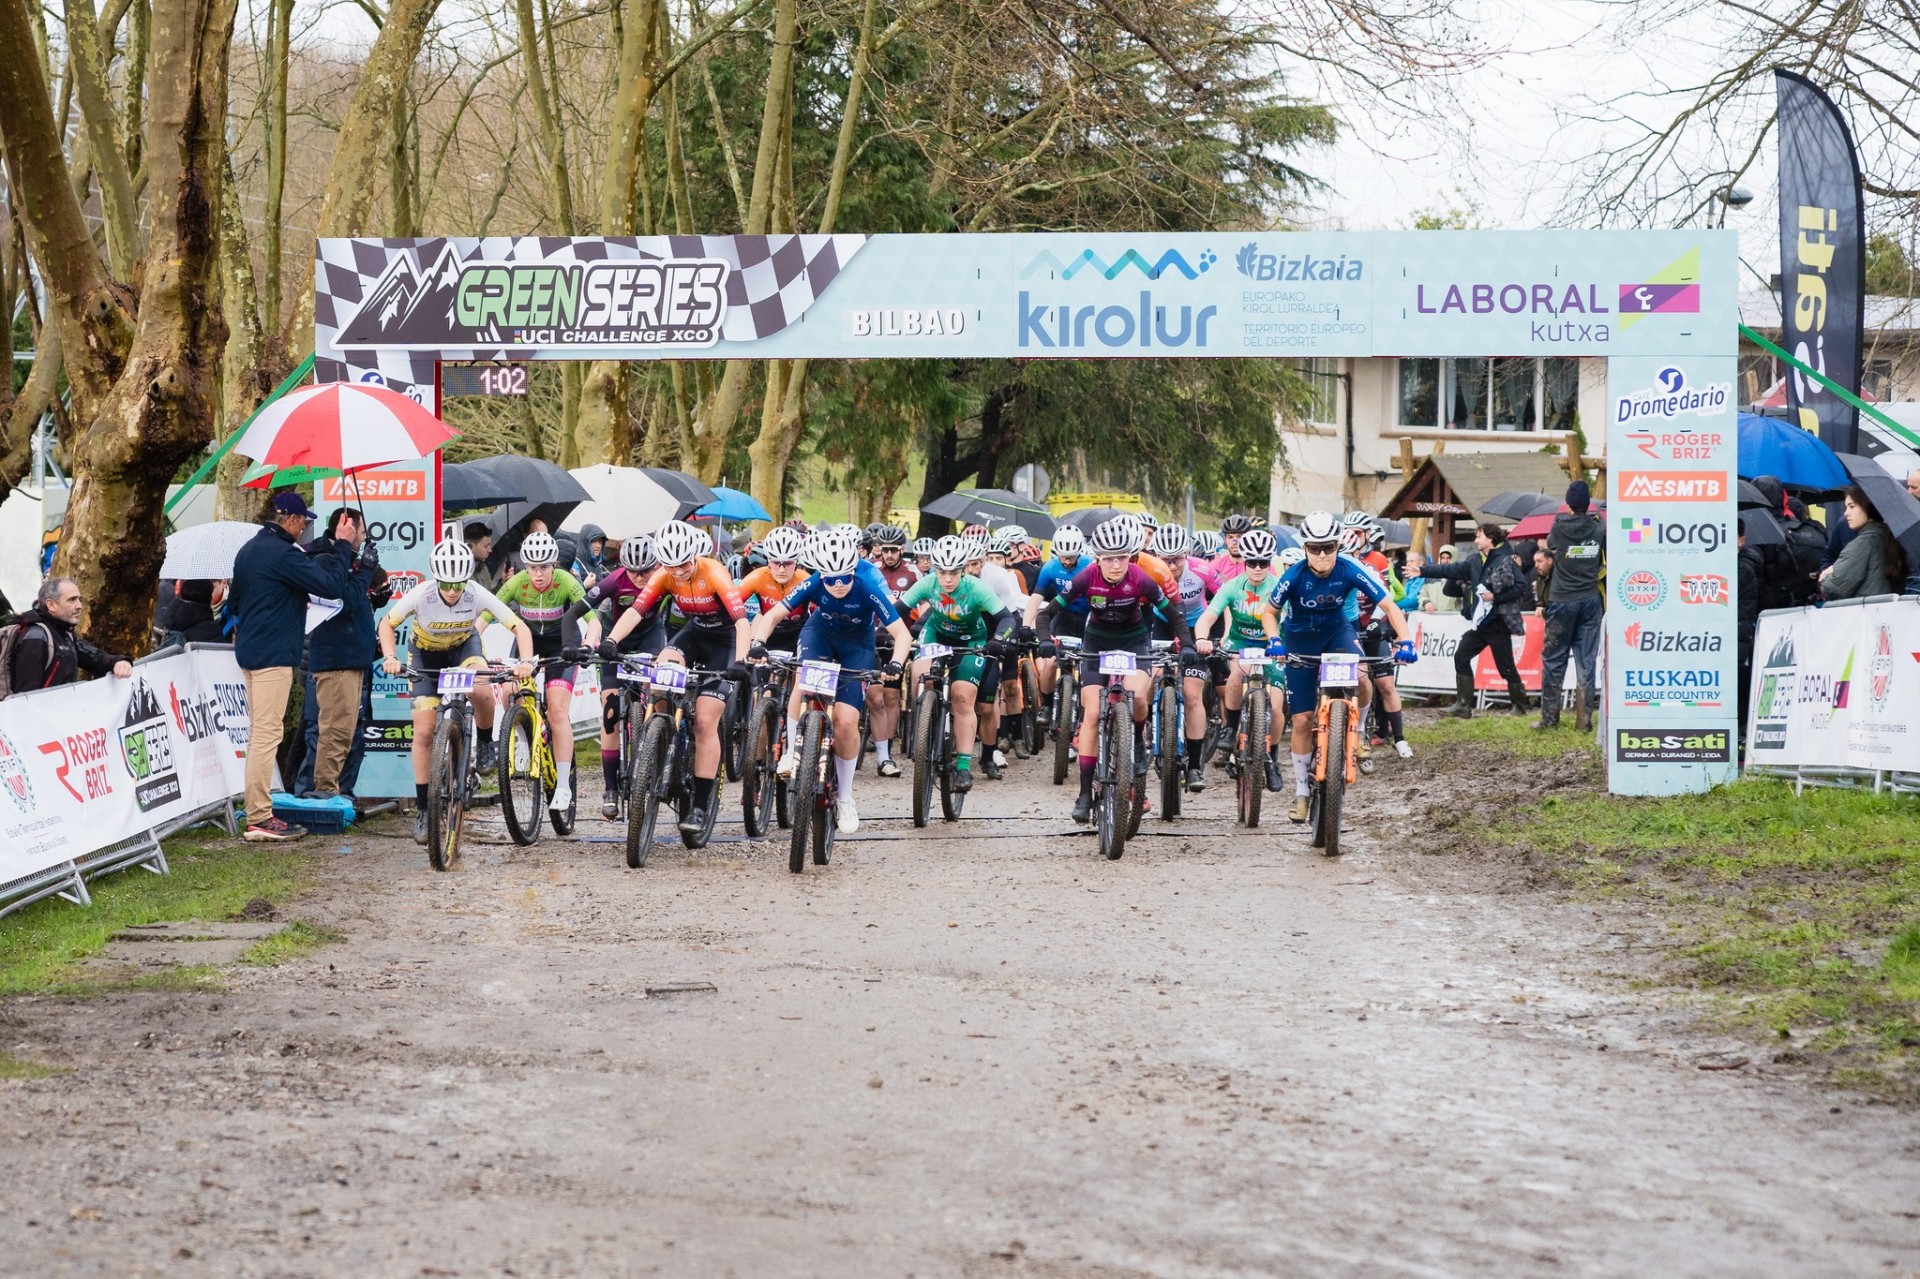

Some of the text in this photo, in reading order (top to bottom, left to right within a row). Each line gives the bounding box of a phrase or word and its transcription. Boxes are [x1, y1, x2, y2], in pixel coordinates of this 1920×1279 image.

[1256, 254, 1363, 281] Bizkaia
[456, 266, 722, 327] GREEN SERIES
[1242, 291, 1305, 302] EUROPAKO
[1417, 283, 1609, 314] LABORAL
[1242, 303, 1339, 314] KIROL LURRALDEA
[851, 308, 965, 337] BILBAO
[1018, 290, 1217, 348] kirolur
[521, 329, 709, 344] UCI CHALLENGE XCO
[1243, 323, 1366, 334] TERRITORIO EUROPEO
[1530, 319, 1610, 343] kutxa
[1243, 336, 1317, 347] DEL DEPORTE
[480, 367, 526, 395] 1:02
[1617, 386, 1725, 423] Dromedario
[1661, 434, 1722, 446] ROGER
[1672, 447, 1712, 459] BRIZ
[1624, 475, 1720, 497] MESMTB
[367, 521, 425, 550] orgi
[680, 595, 715, 604] Occident
[1300, 594, 1344, 608] LOGOS
[818, 608, 862, 625] OGOS
[1421, 632, 1455, 657] Bizka
[1640, 631, 1722, 652] Bizkaia
[443, 673, 467, 688] 811
[655, 669, 679, 687] 801
[1624, 670, 1720, 687] EUSKADI
[1624, 690, 1721, 701] BASQUE COUNTRY
[67, 727, 108, 767] ROGER
[1620, 732, 1726, 750] basati
[85, 763, 113, 800] BRIZ
